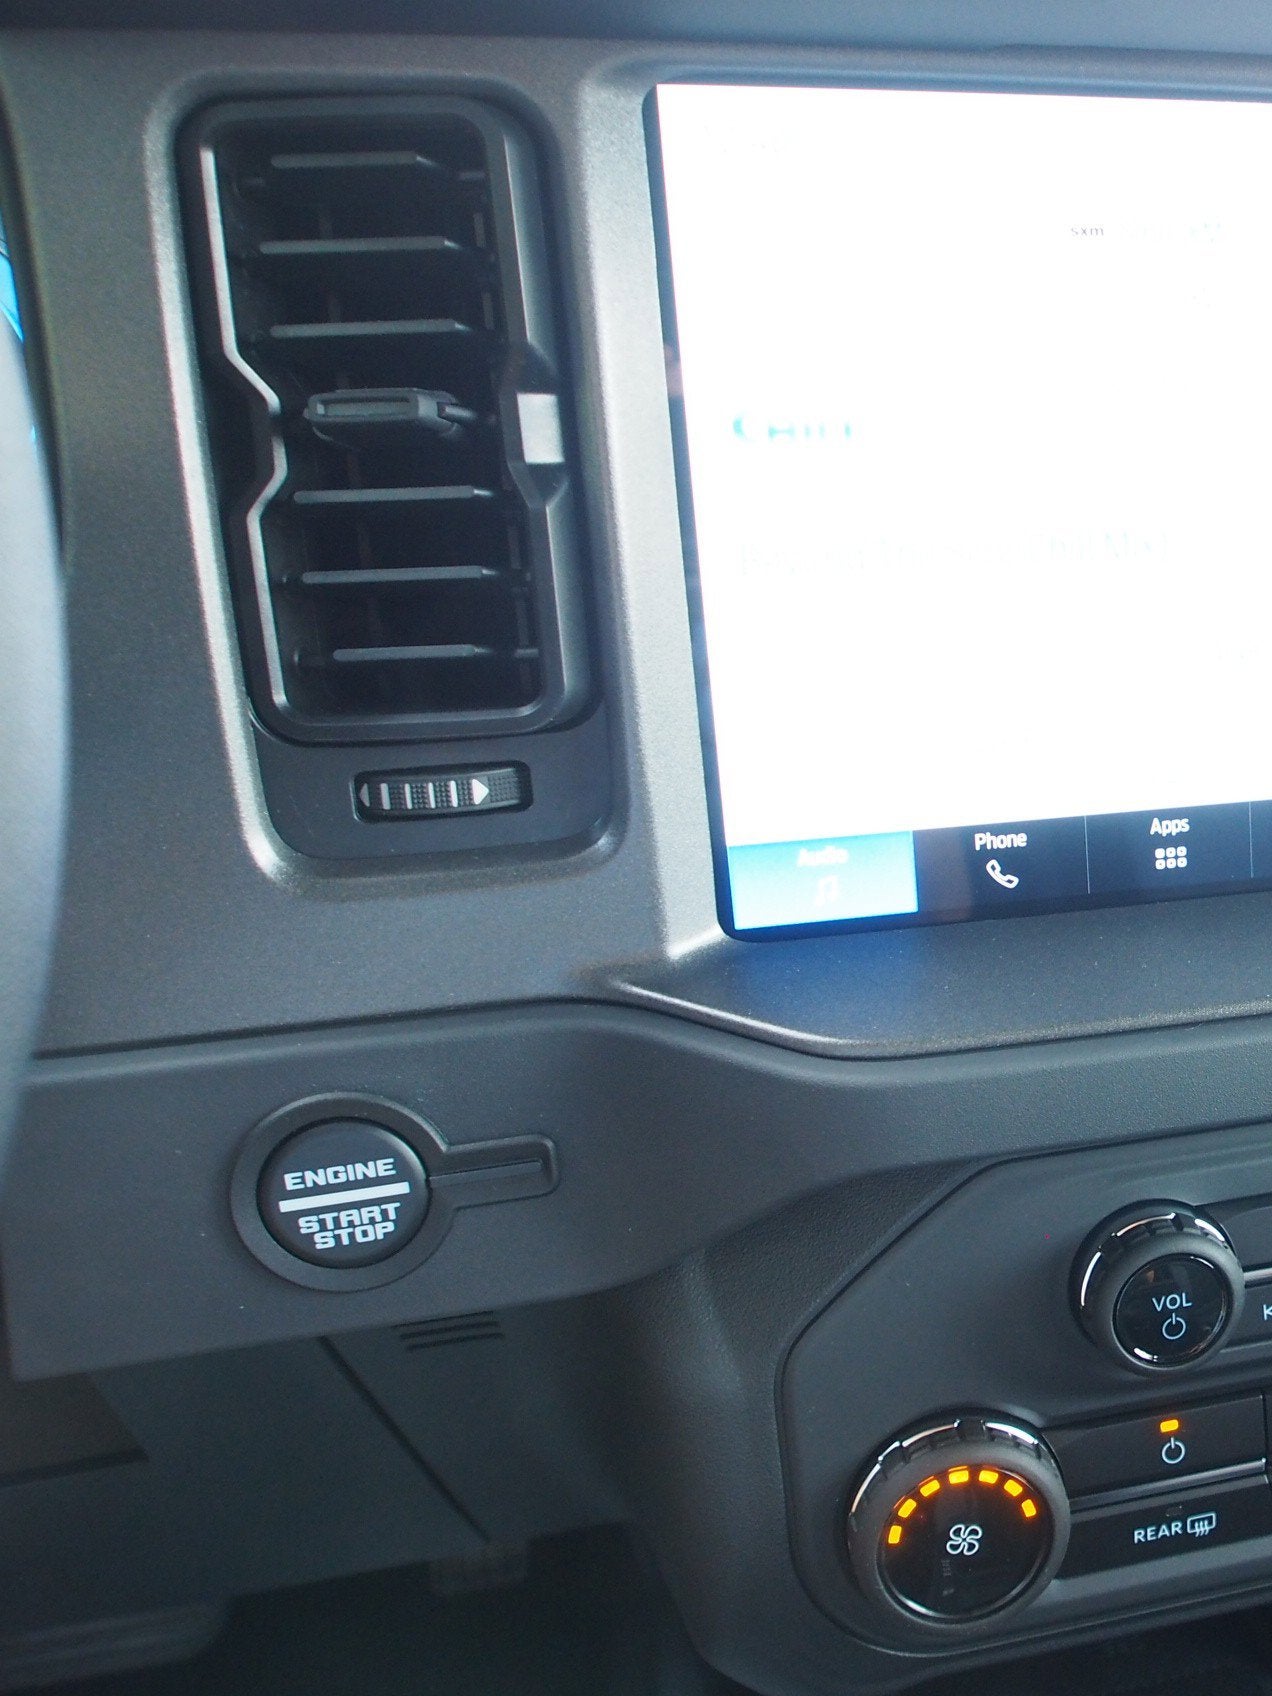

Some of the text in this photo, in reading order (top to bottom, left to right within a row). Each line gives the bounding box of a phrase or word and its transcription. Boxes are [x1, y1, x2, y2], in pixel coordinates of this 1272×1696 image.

[1069, 226, 1105, 237] sxm
[1150, 815, 1190, 837] Apps
[974, 830, 1027, 852] Phone
[283, 1157, 397, 1191] ENGINE
[298, 1202, 401, 1235] START
[313, 1220, 396, 1250] STOP
[1152, 1292, 1193, 1311] VOL
[1133, 1519, 1183, 1545] REAR
